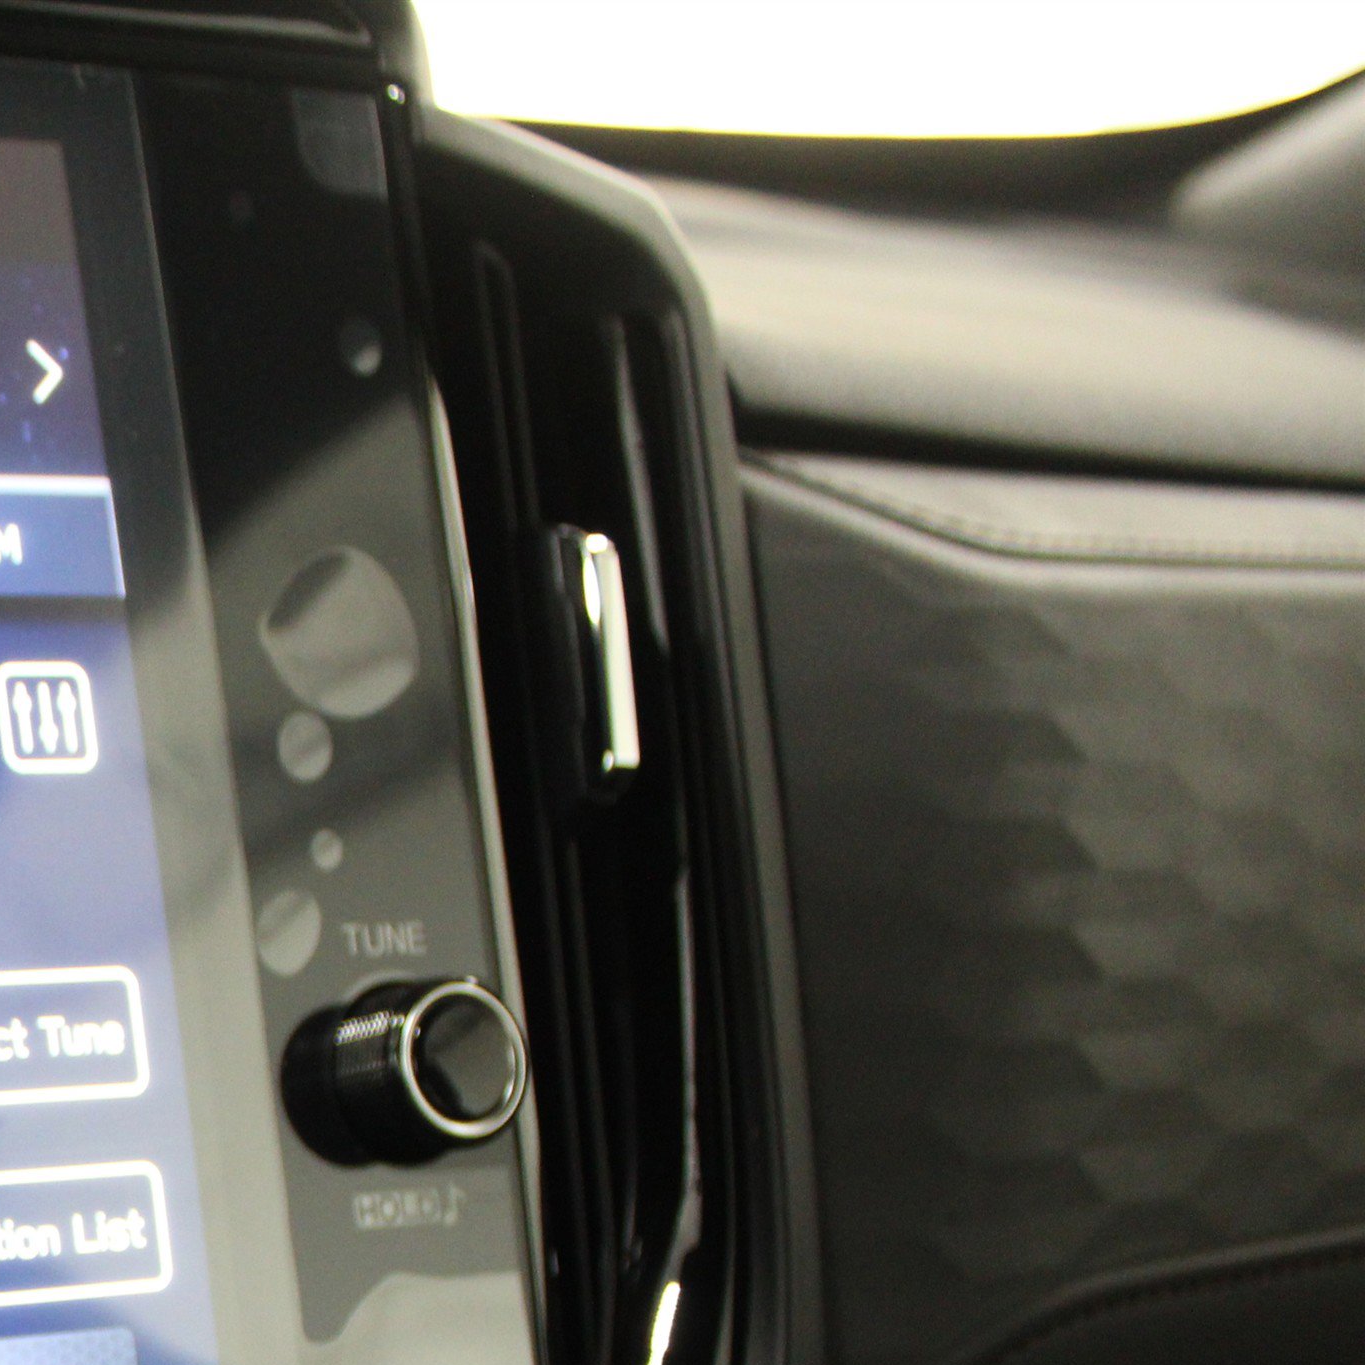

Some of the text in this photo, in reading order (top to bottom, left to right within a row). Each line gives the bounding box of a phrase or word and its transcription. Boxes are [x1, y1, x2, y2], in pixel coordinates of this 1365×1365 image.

[341, 920, 426, 956] TUNE
[39, 1013, 124, 1061] Tune
[73, 1207, 146, 1255] List
